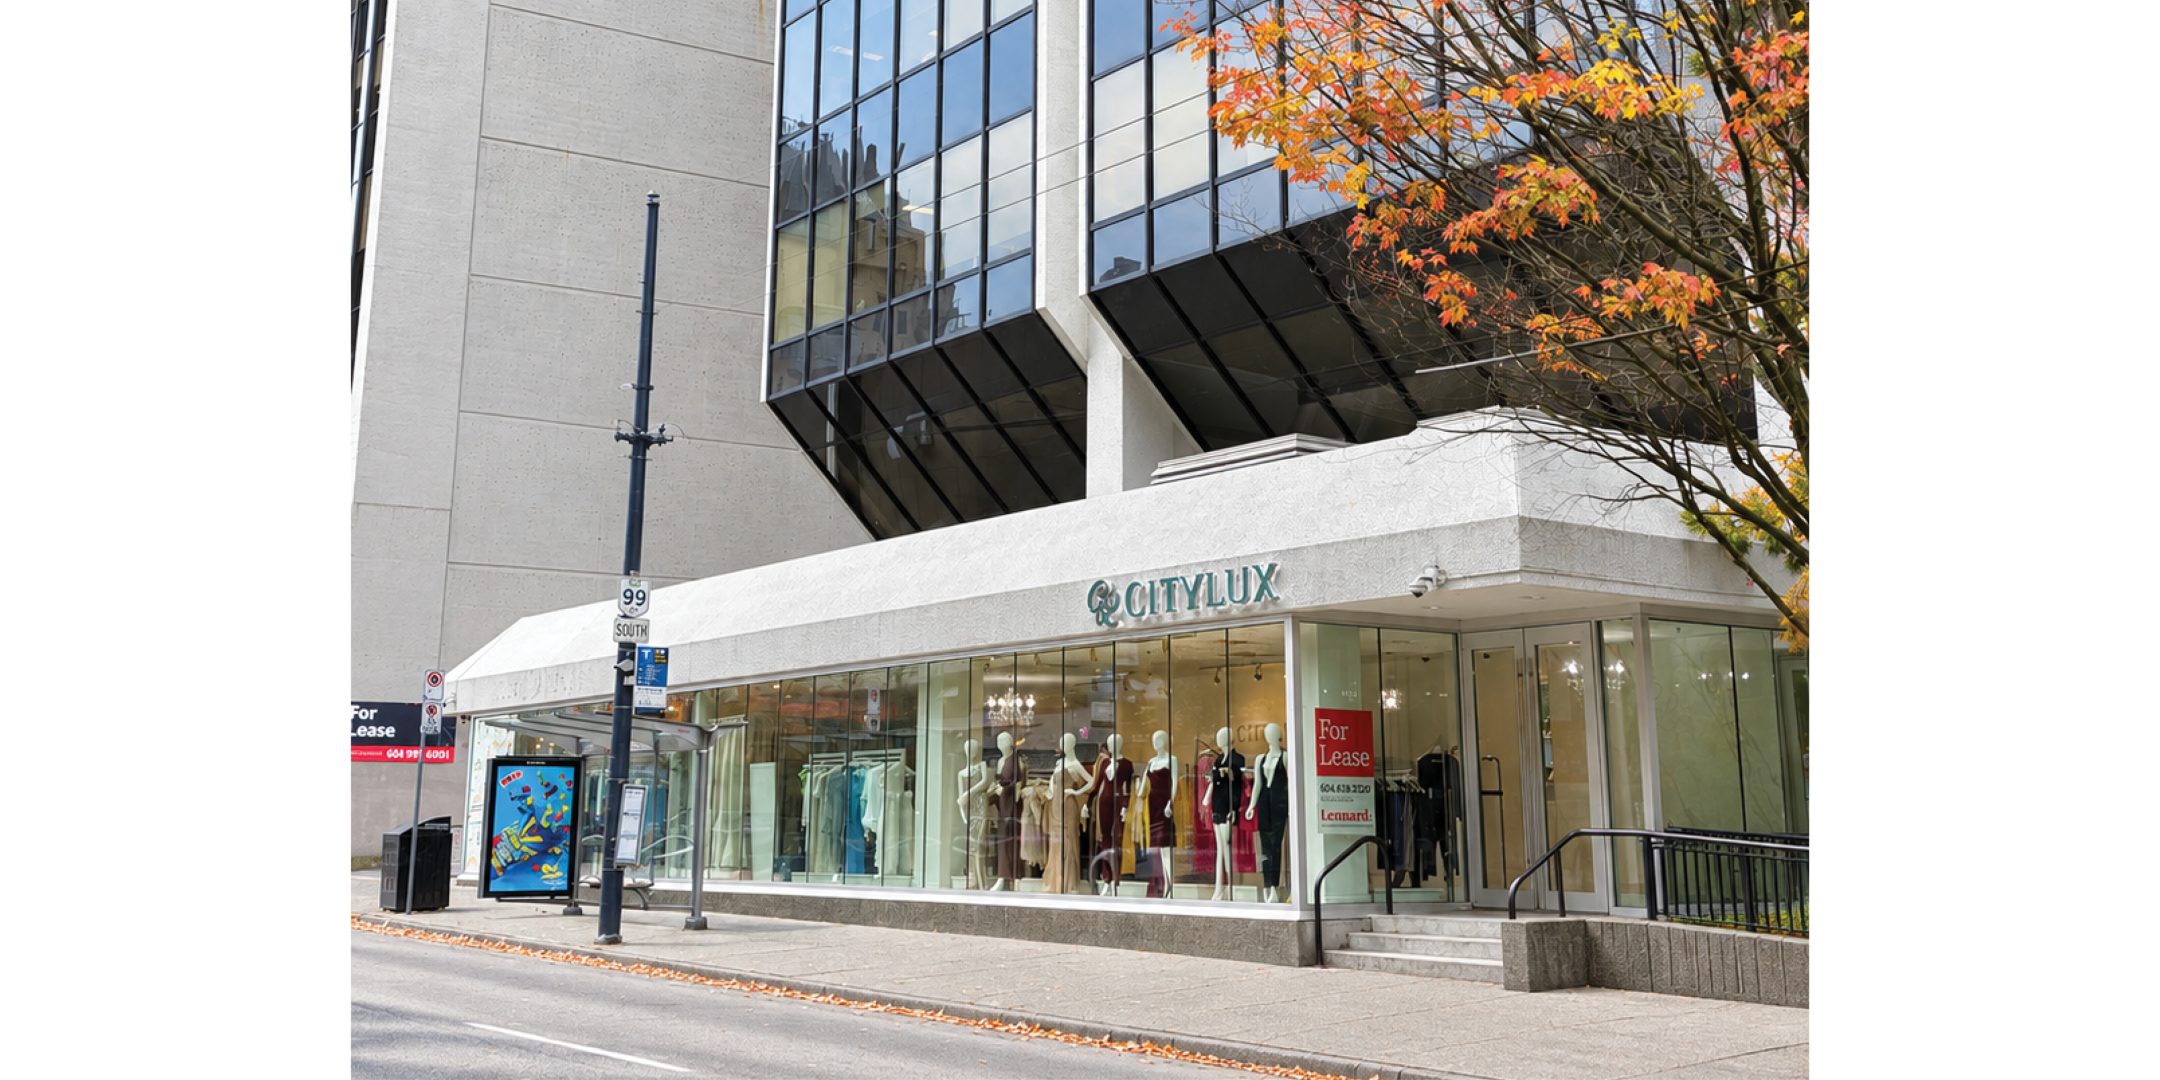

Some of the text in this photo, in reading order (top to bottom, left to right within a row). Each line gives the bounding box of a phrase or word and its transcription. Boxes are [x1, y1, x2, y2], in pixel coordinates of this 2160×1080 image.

[623, 588, 646, 607] 99
[1124, 562, 1280, 618] CITYLUX
[616, 623, 647, 638] SOUTH
[350, 705, 378, 720] For
[1318, 718, 1349, 740] For
[1319, 744, 1370, 767] Lease
